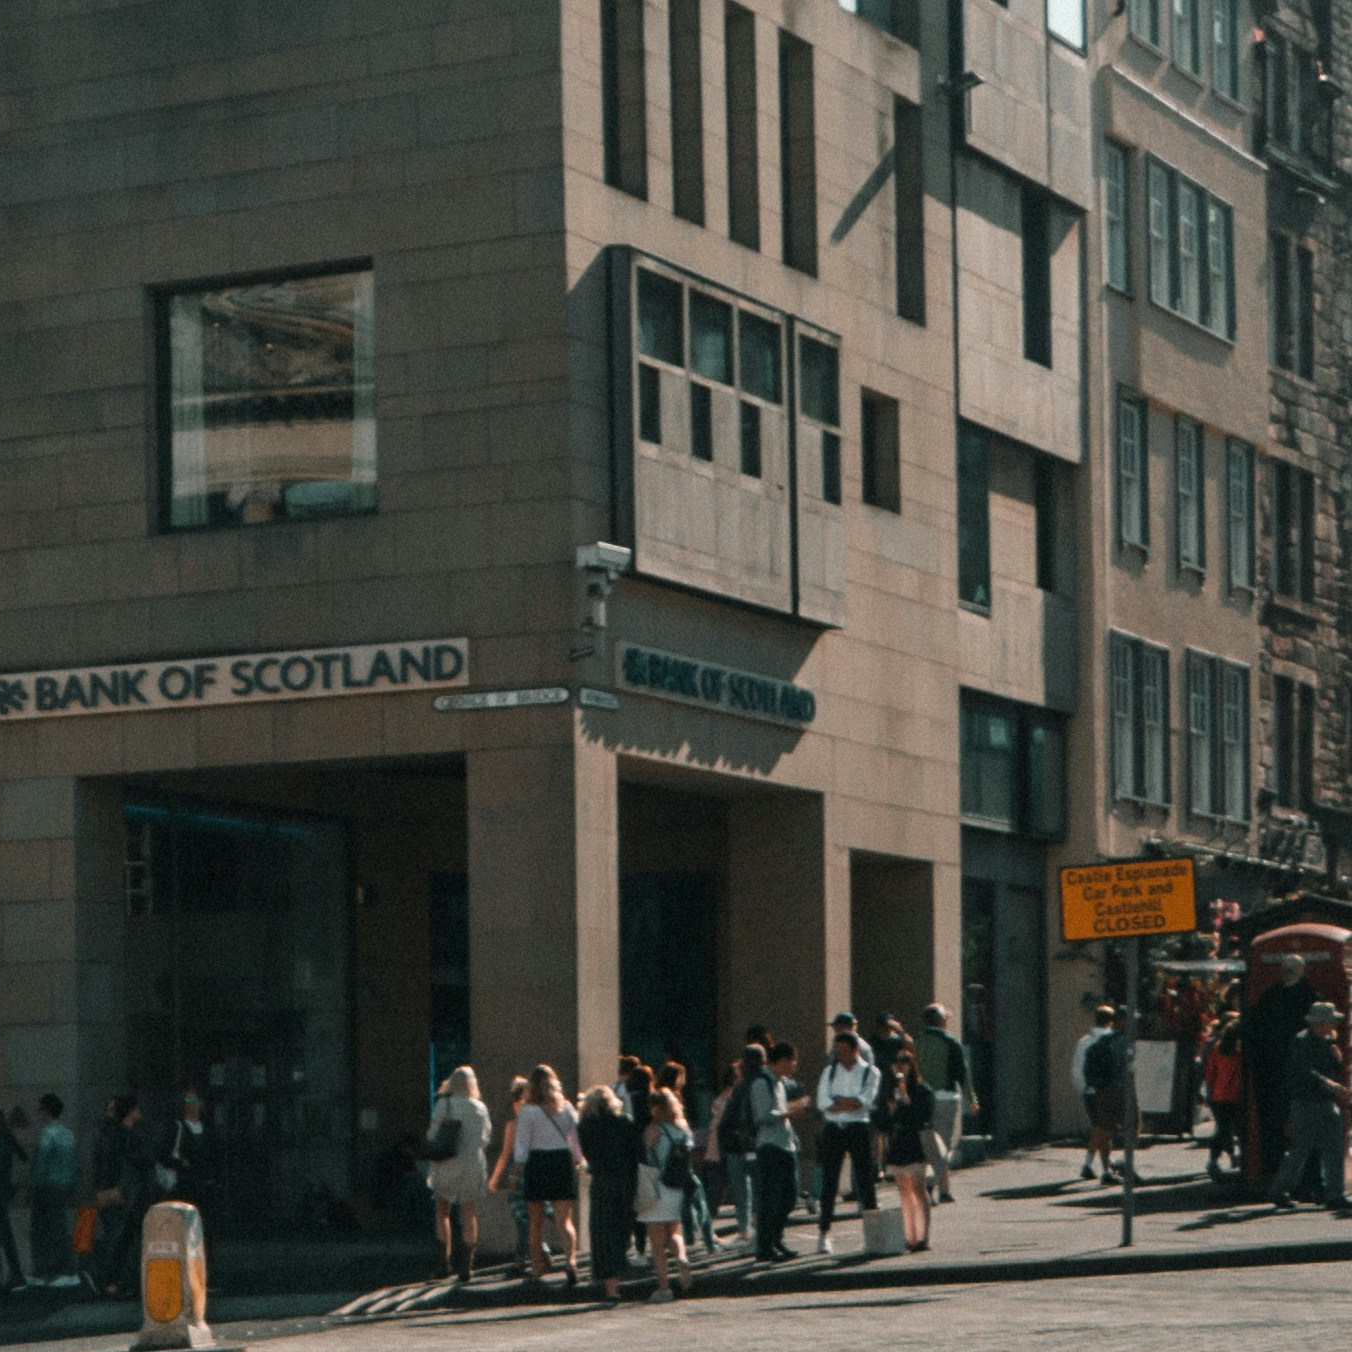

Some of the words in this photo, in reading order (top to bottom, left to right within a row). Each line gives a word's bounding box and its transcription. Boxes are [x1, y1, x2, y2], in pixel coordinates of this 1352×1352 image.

[34, 668, 149, 712] BANK
[158, 663, 217, 700] OF
[230, 644, 465, 697] SCOTLAND
[1111, 883, 1142, 898] Park
[1147, 881, 1173, 896] and
[1092, 914, 1167, 933] CLOSED
